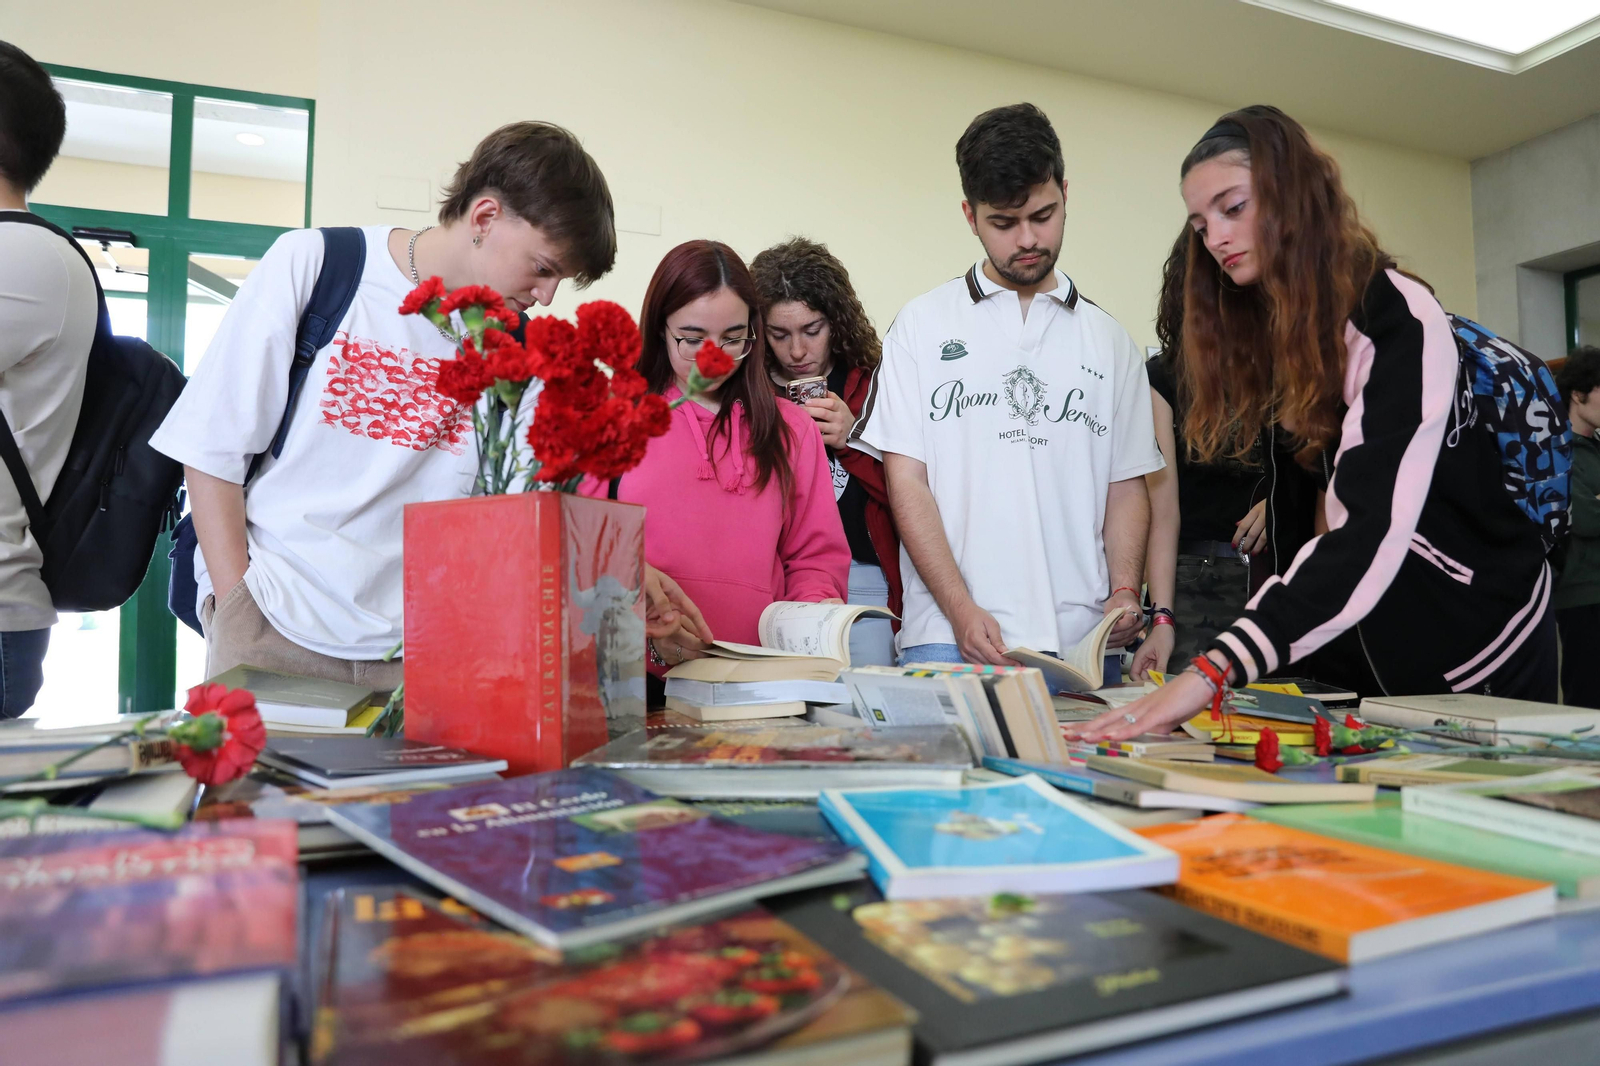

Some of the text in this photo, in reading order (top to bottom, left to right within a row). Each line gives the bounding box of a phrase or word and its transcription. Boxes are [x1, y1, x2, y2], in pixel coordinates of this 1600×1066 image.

[929, 377, 1110, 437] Room Service
[998, 429, 1027, 440] HOTEL
[543, 565, 555, 725] TAUROMACHIE
